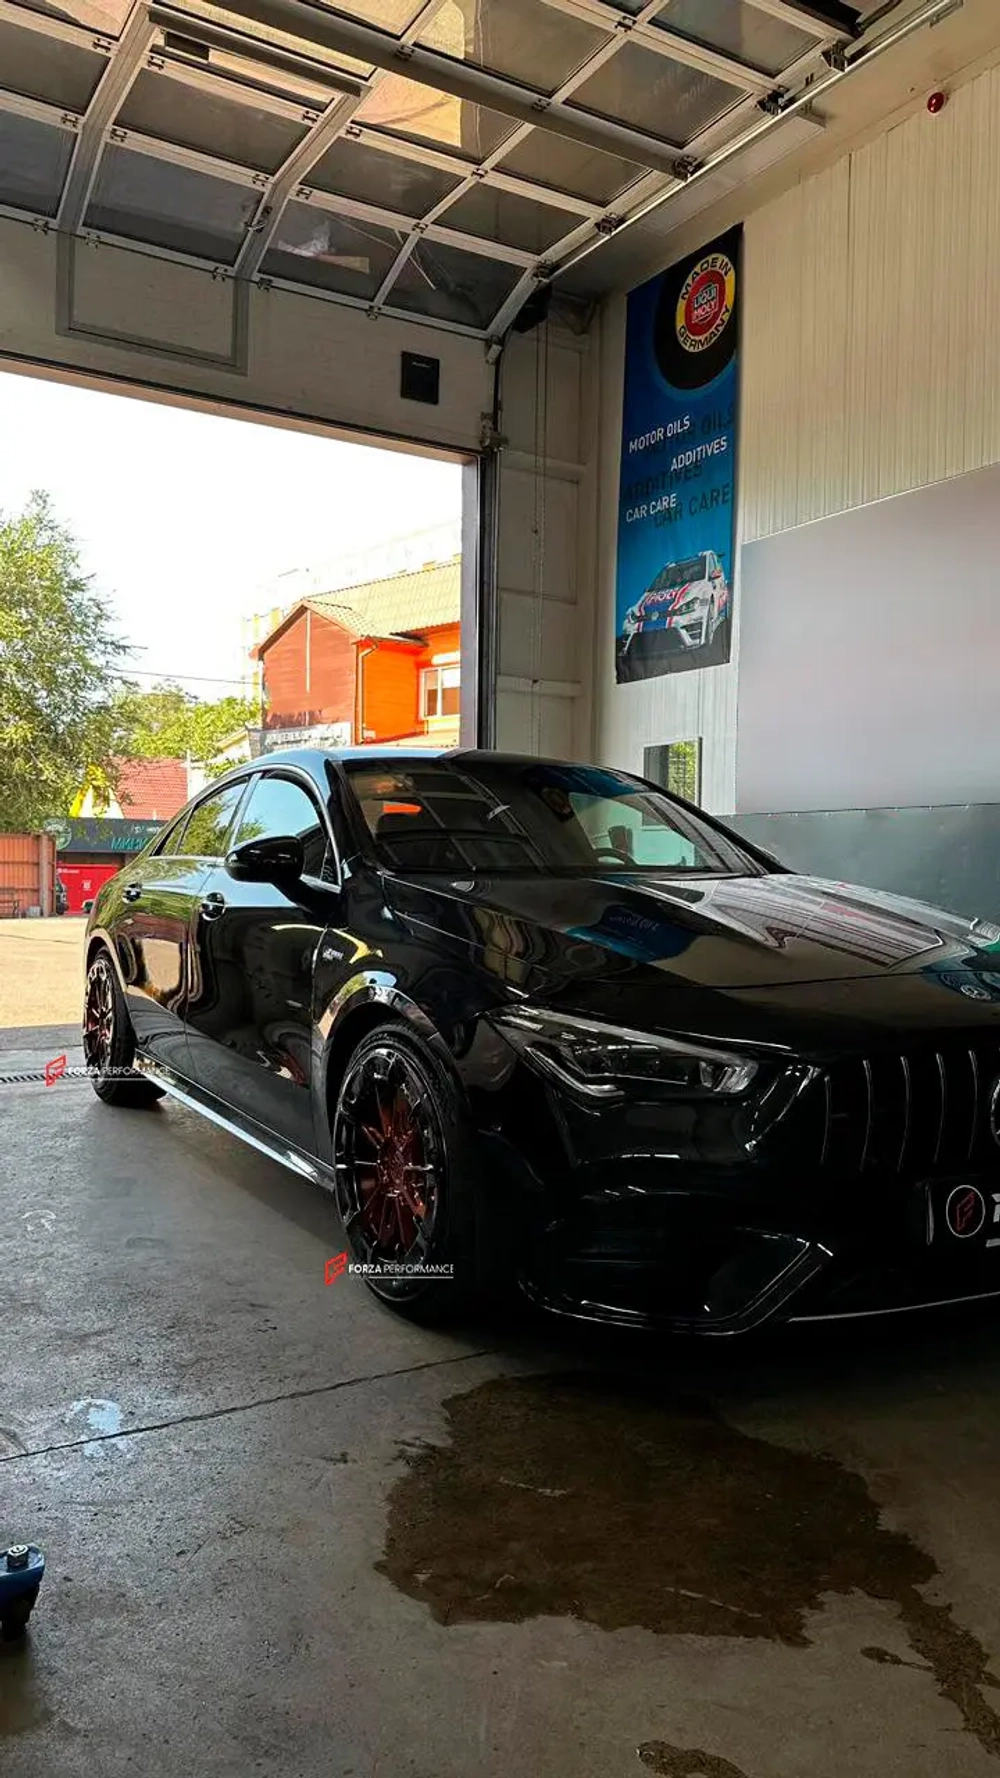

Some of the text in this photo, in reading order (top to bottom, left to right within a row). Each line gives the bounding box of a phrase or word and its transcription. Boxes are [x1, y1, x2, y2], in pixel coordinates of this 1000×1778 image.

[681, 257, 732, 300] MADE IN
[678, 305, 731, 350] GERMANY
[629, 415, 691, 454] MOTOR OILS
[670, 435, 728, 472] ADDITIVES
[626, 493, 678, 522] CAR CARE
[689, 482, 731, 516] CARE
